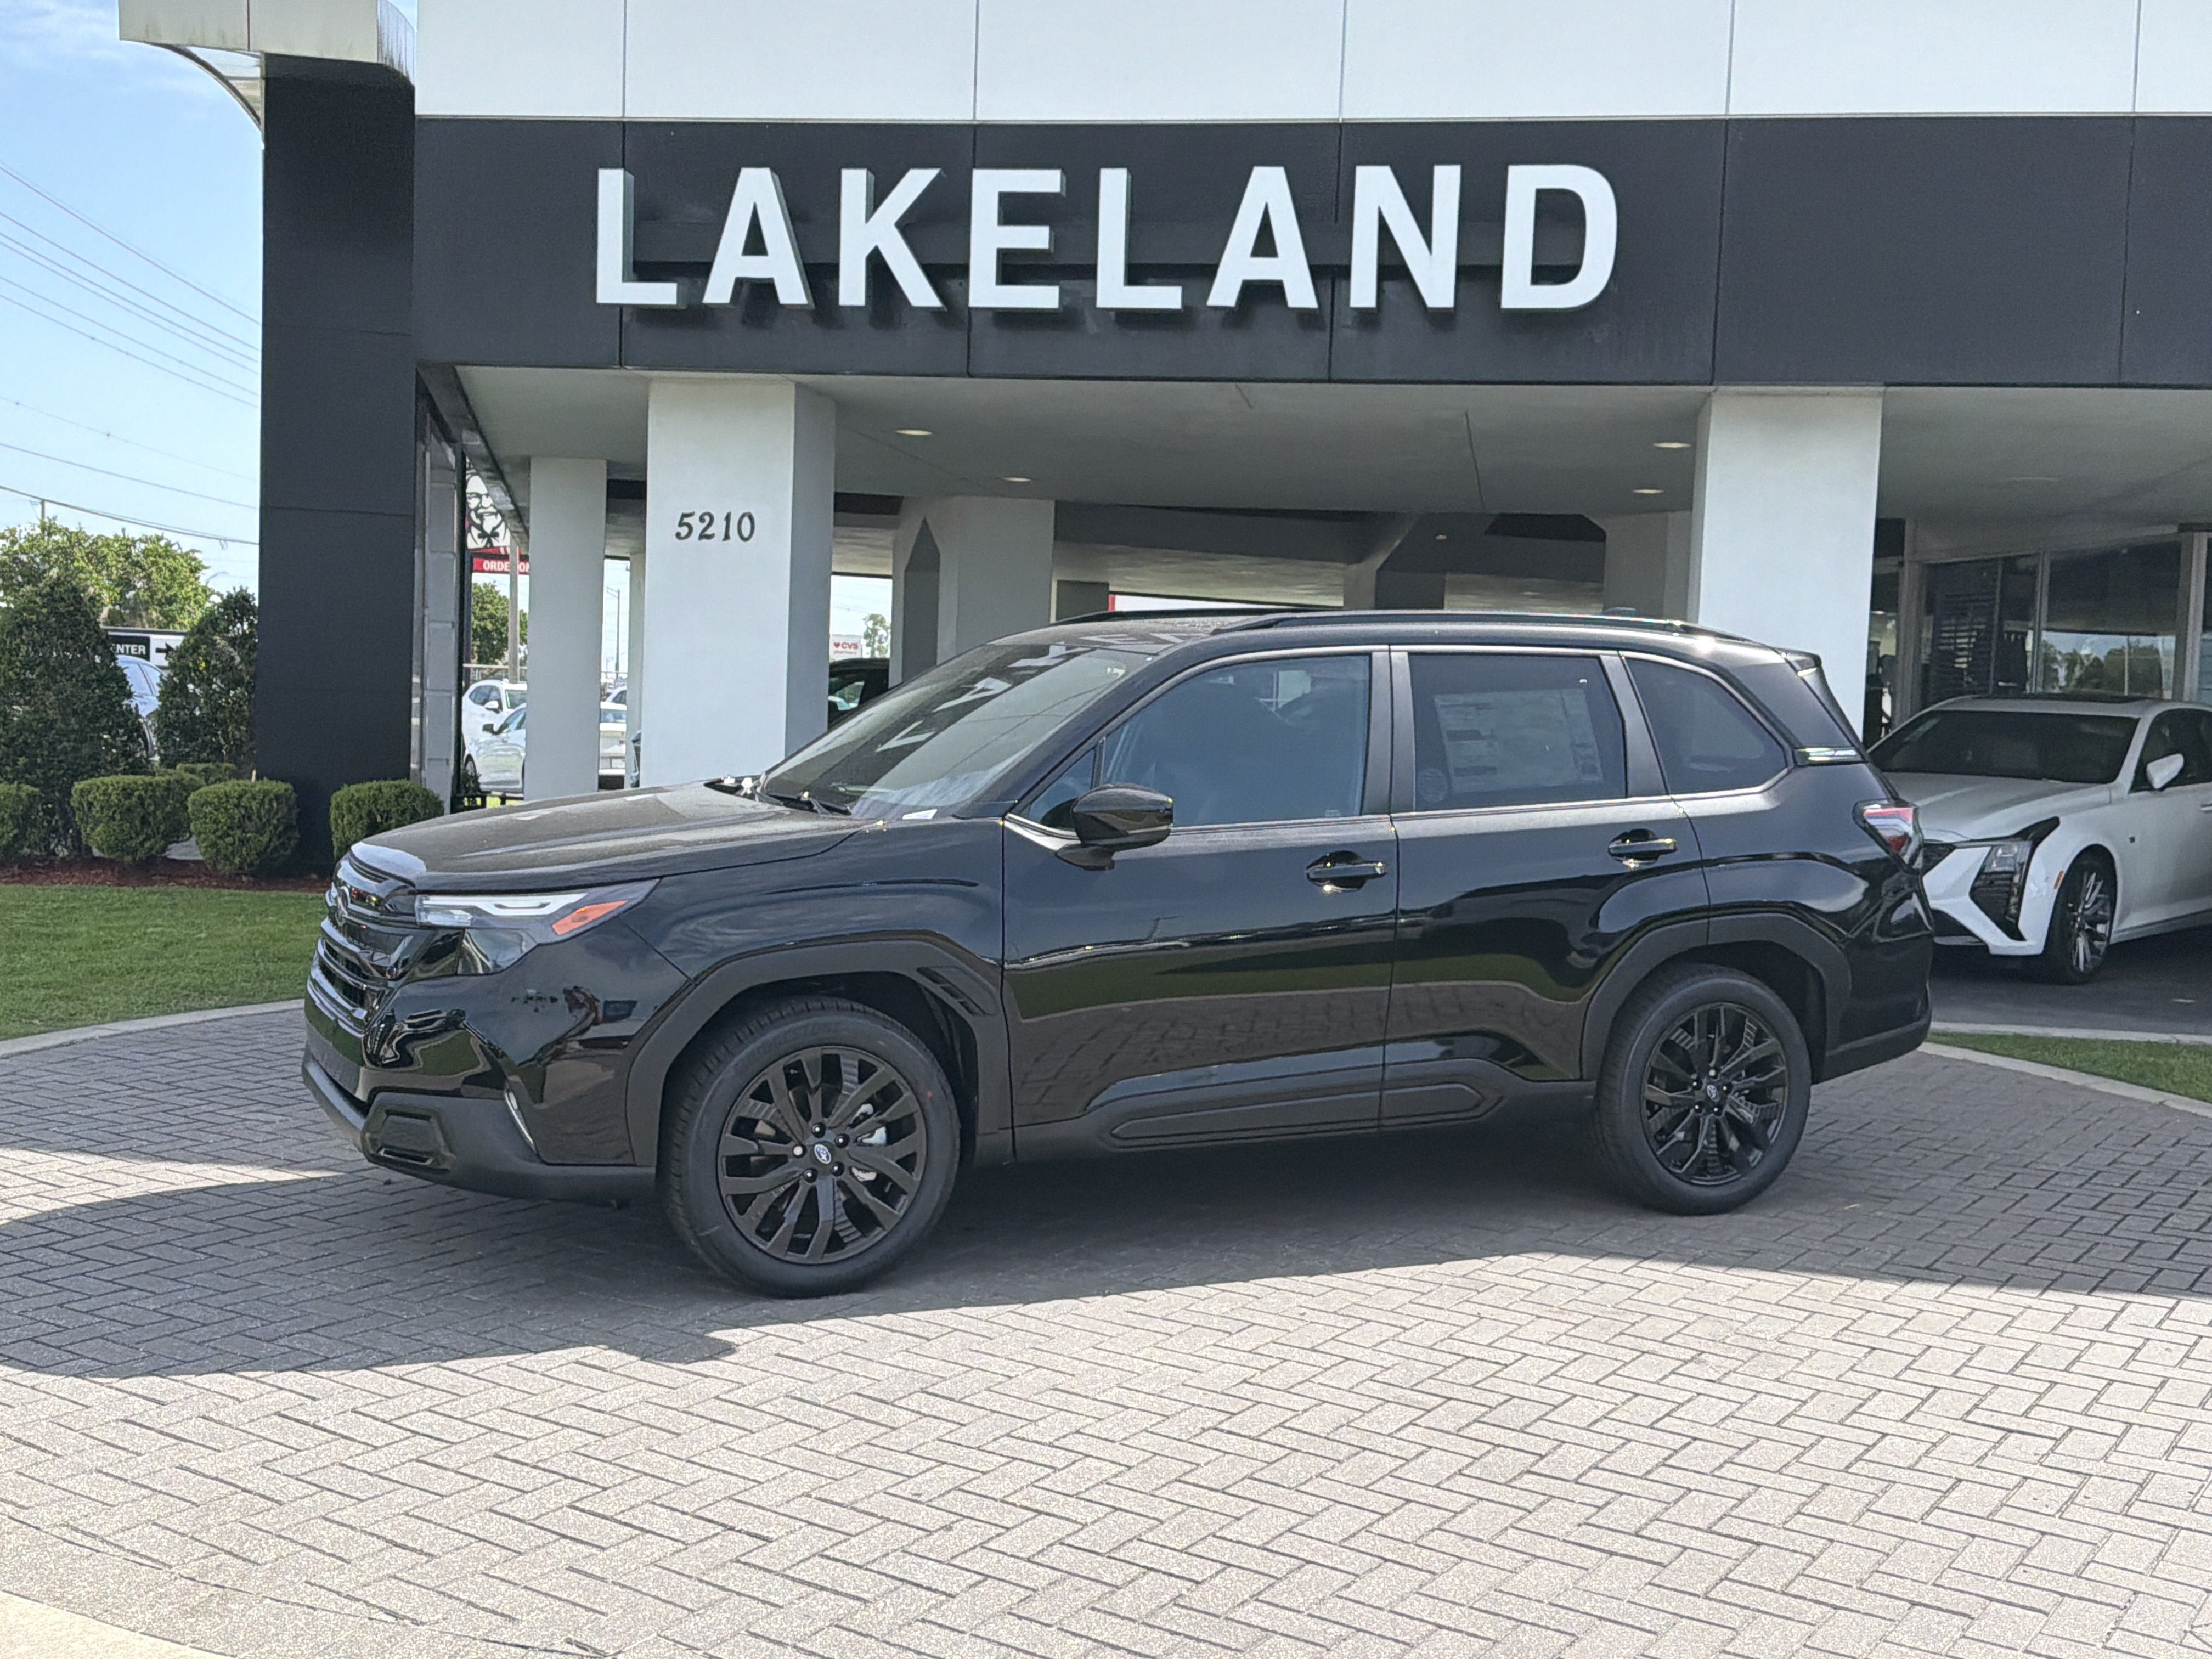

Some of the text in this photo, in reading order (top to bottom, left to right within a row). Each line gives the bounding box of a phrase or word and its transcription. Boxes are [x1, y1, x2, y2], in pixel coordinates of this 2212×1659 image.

[596, 164, 1618, 312] LAKELAND
[675, 511, 756, 543] 5210
[482, 560, 510, 572] ORDE
[841, 641, 859, 650] CVS
